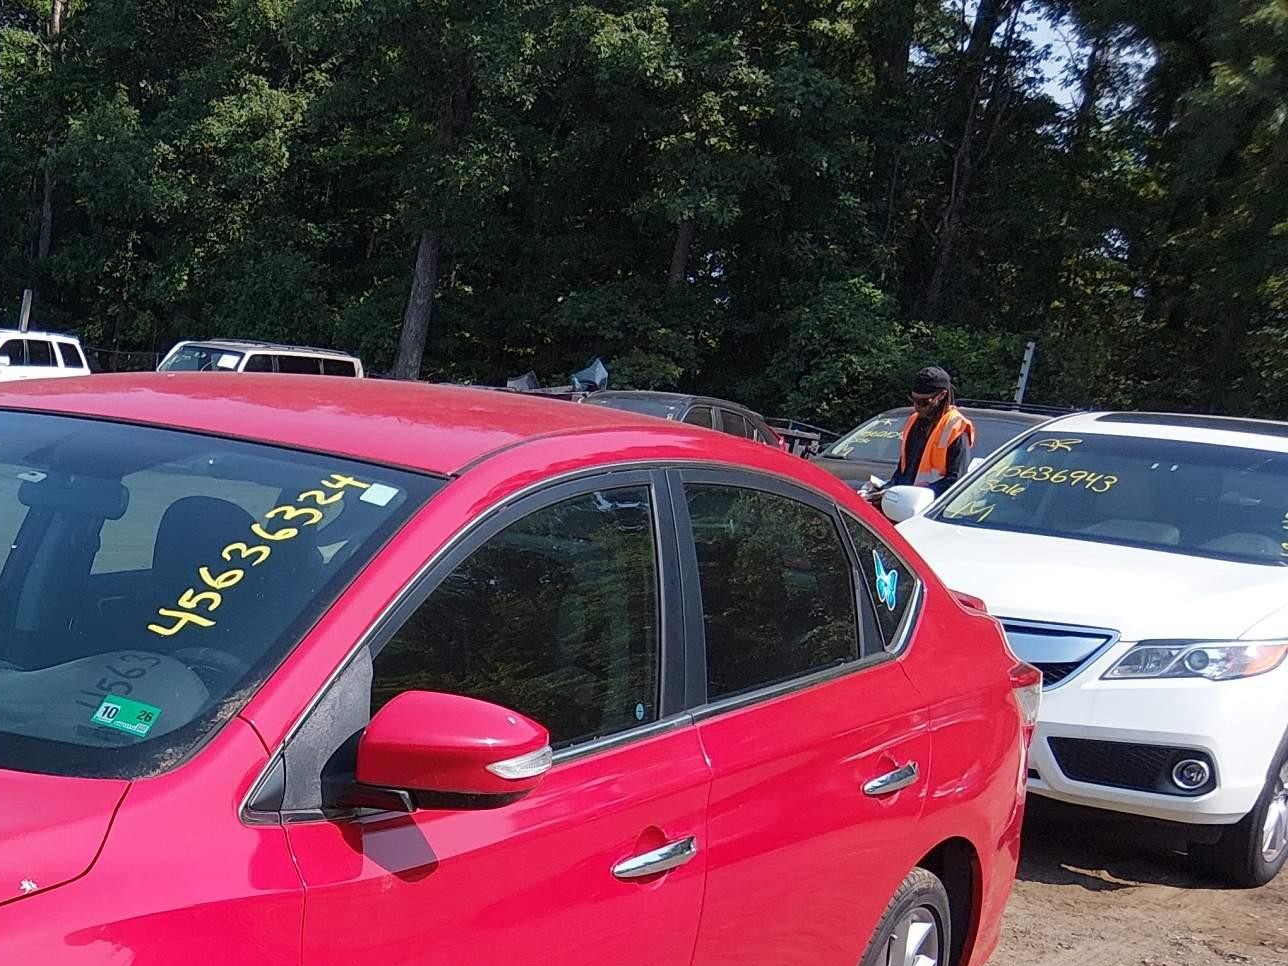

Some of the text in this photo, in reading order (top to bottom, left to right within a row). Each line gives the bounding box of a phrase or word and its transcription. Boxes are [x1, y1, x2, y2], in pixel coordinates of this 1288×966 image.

[147, 473, 371, 636] 45636324
[101, 705, 154, 723] 10 26
